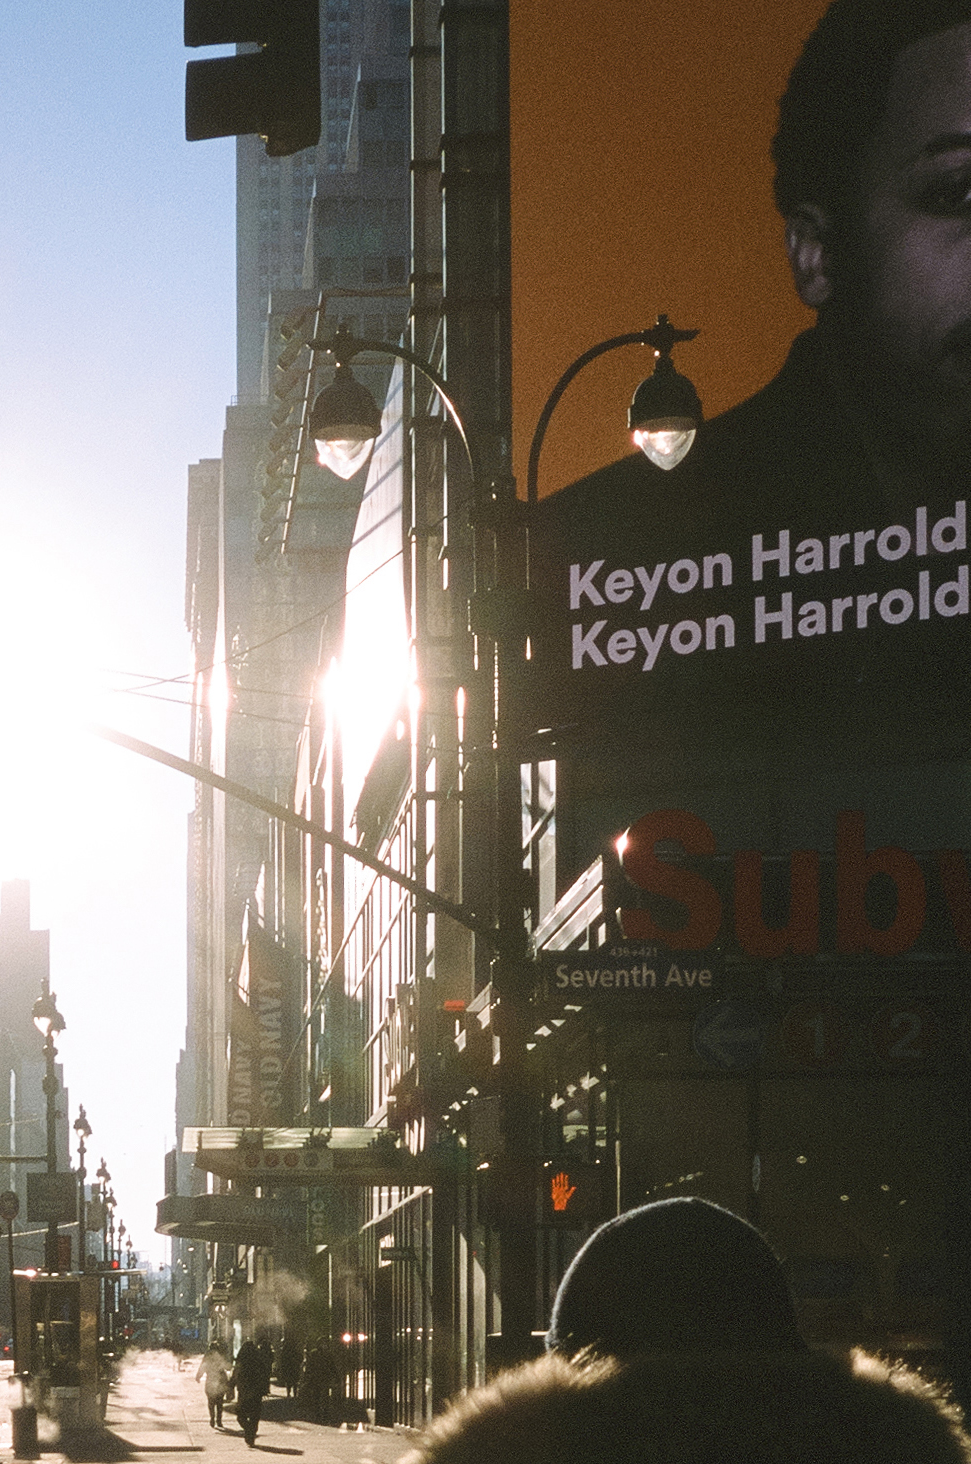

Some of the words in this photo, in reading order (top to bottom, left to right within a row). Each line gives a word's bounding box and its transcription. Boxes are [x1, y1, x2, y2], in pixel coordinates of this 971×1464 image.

[569, 553, 733, 611] Keyon
[752, 500, 967, 582] Harrold
[571, 614, 735, 672] Keyon
[754, 565, 969, 644] Harrold
[555, 963, 656, 988] Seventh
[664, 963, 713, 988] Ave
[258, 978, 283, 1049] NAVY
[800, 1013, 827, 1059] 1
[888, 1011, 923, 1059] 2
[233, 1041, 252, 1104] NAVY
[260, 1056, 284, 1108] OLD
[310, 1187, 326, 1240] rocs
